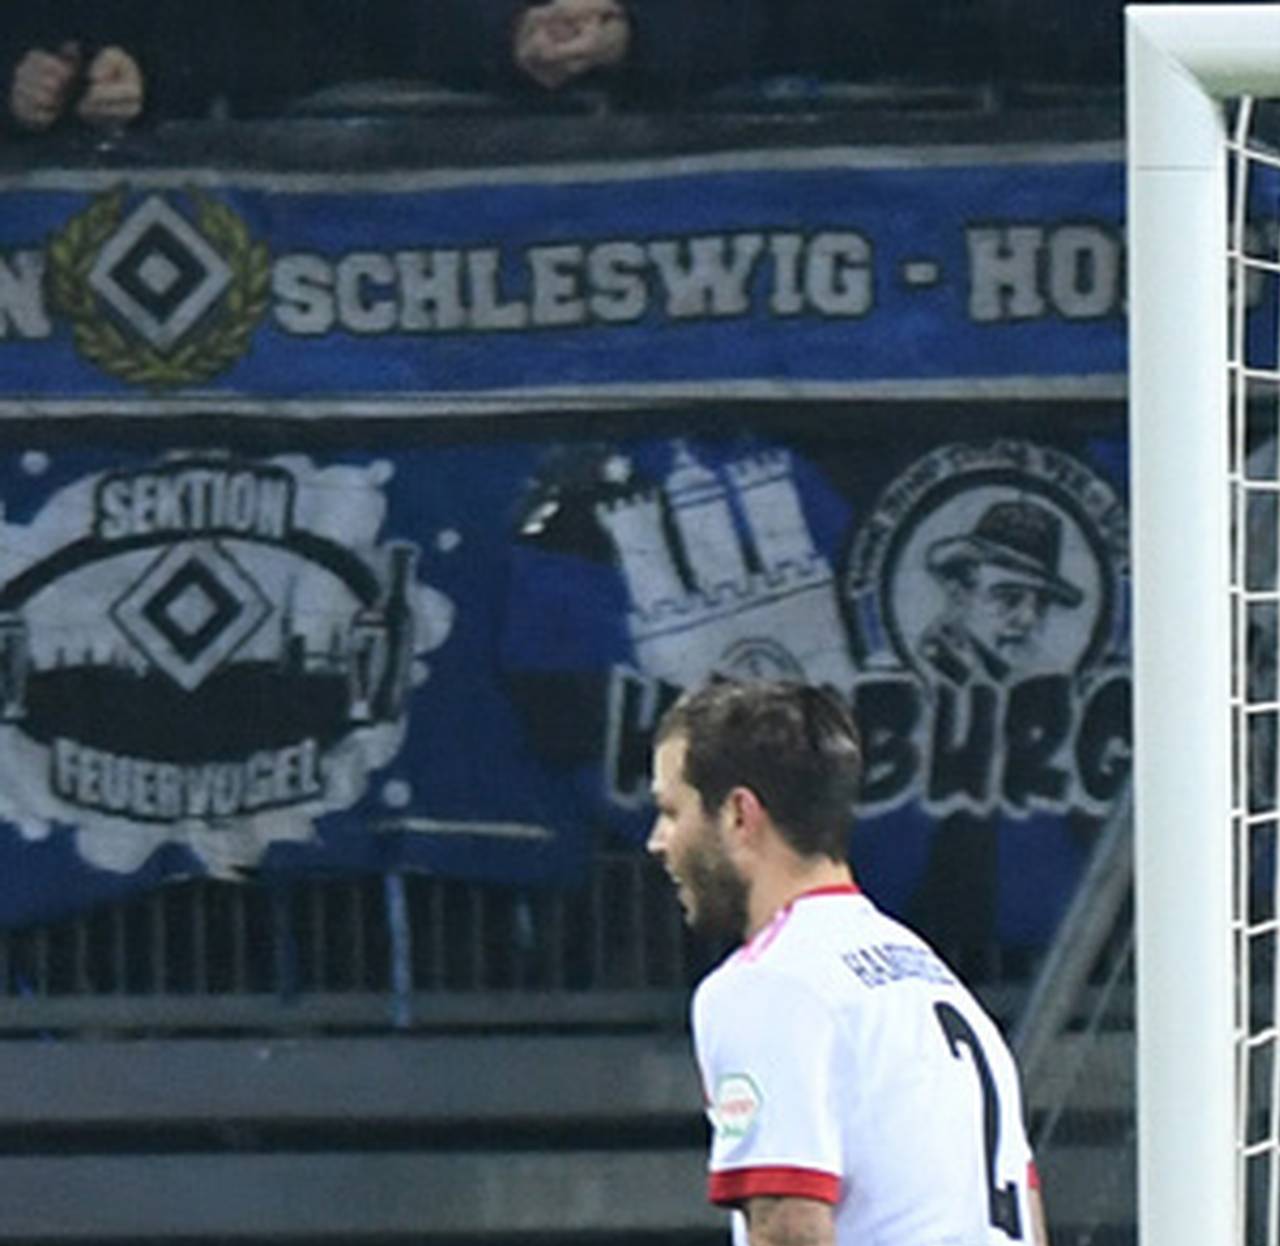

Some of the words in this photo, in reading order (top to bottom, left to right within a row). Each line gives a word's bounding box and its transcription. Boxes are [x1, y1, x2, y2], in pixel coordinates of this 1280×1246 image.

[271, 233, 873, 335] SCHLESWIG
[966, 226, 1126, 322] HO
[101, 469, 288, 537] SEKTION
[933, 1000, 1022, 1241] 2
